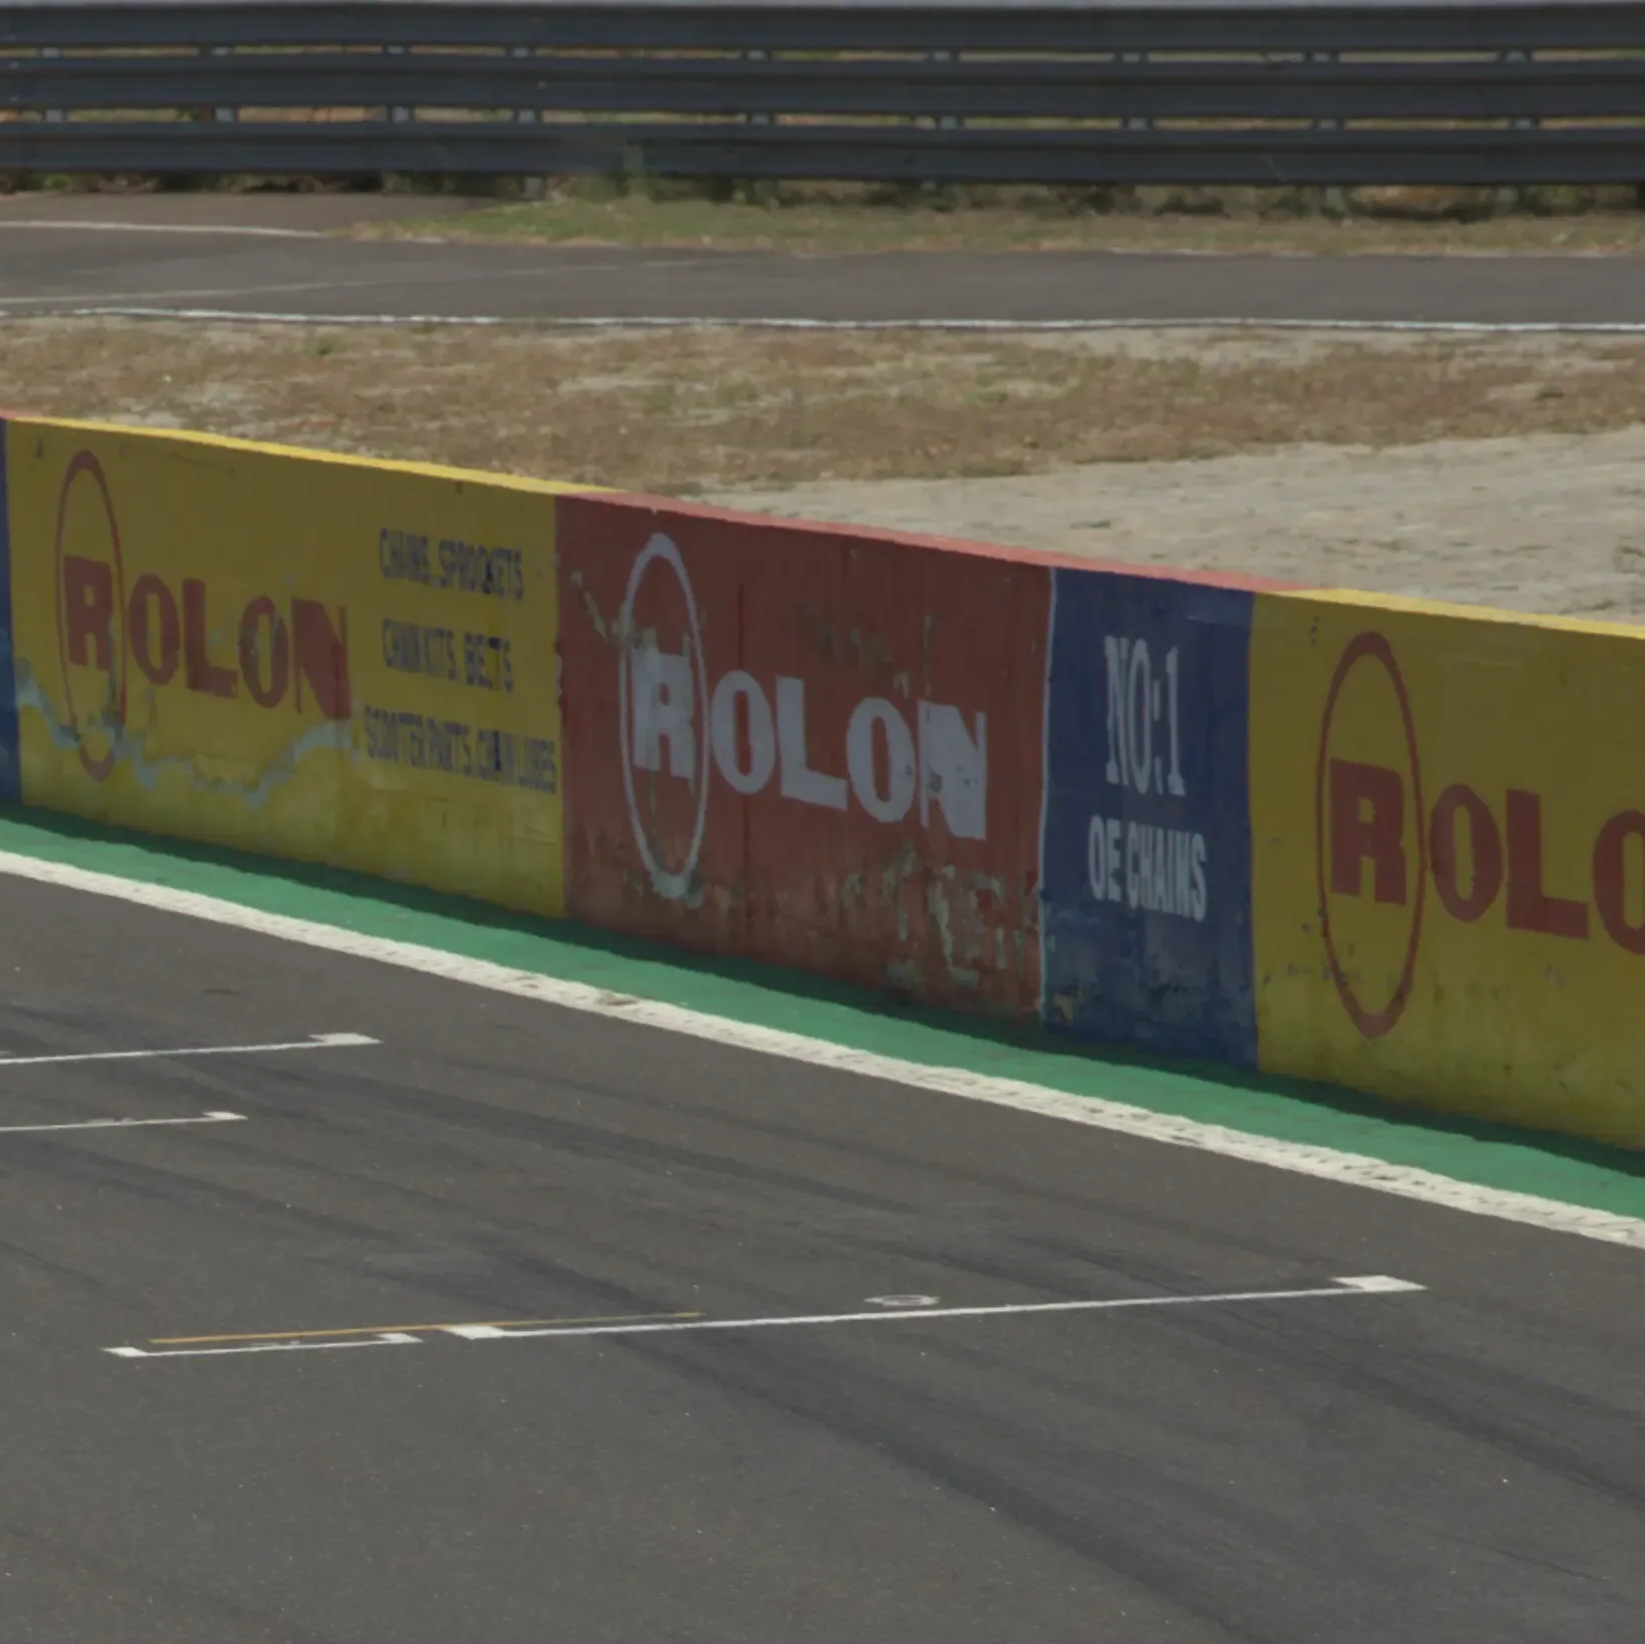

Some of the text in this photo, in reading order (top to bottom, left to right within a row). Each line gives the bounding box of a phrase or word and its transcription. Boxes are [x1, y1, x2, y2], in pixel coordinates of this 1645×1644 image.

[63, 555, 351, 723] ROLON
[1104, 635, 1187, 797] NO:1
[630, 646, 989, 841] ROLON
[1088, 813, 1208, 923] OE CHAINS
